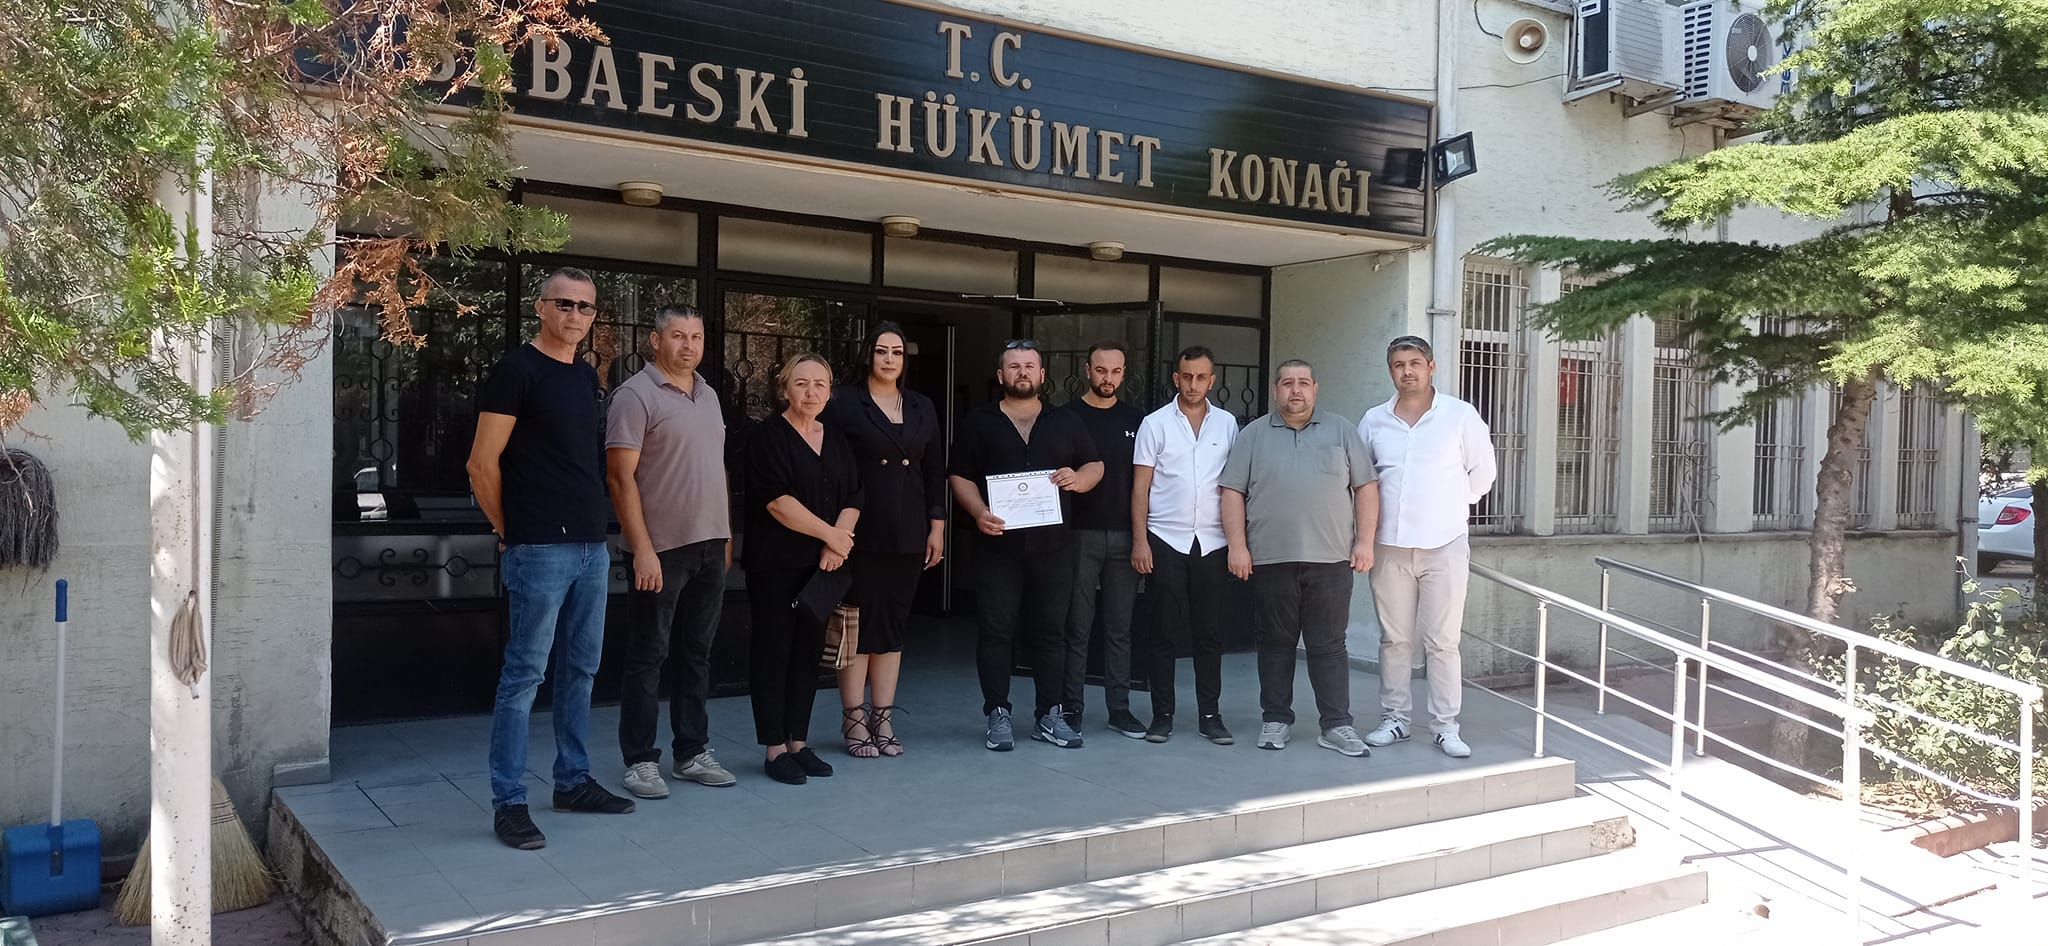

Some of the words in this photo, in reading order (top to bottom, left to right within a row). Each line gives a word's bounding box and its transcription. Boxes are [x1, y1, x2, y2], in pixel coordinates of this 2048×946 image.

[415, 24, 809, 138] BAESKİ
[875, 91, 1162, 189] HÜKÜMET
[1207, 146, 1373, 218] KONAĞI
